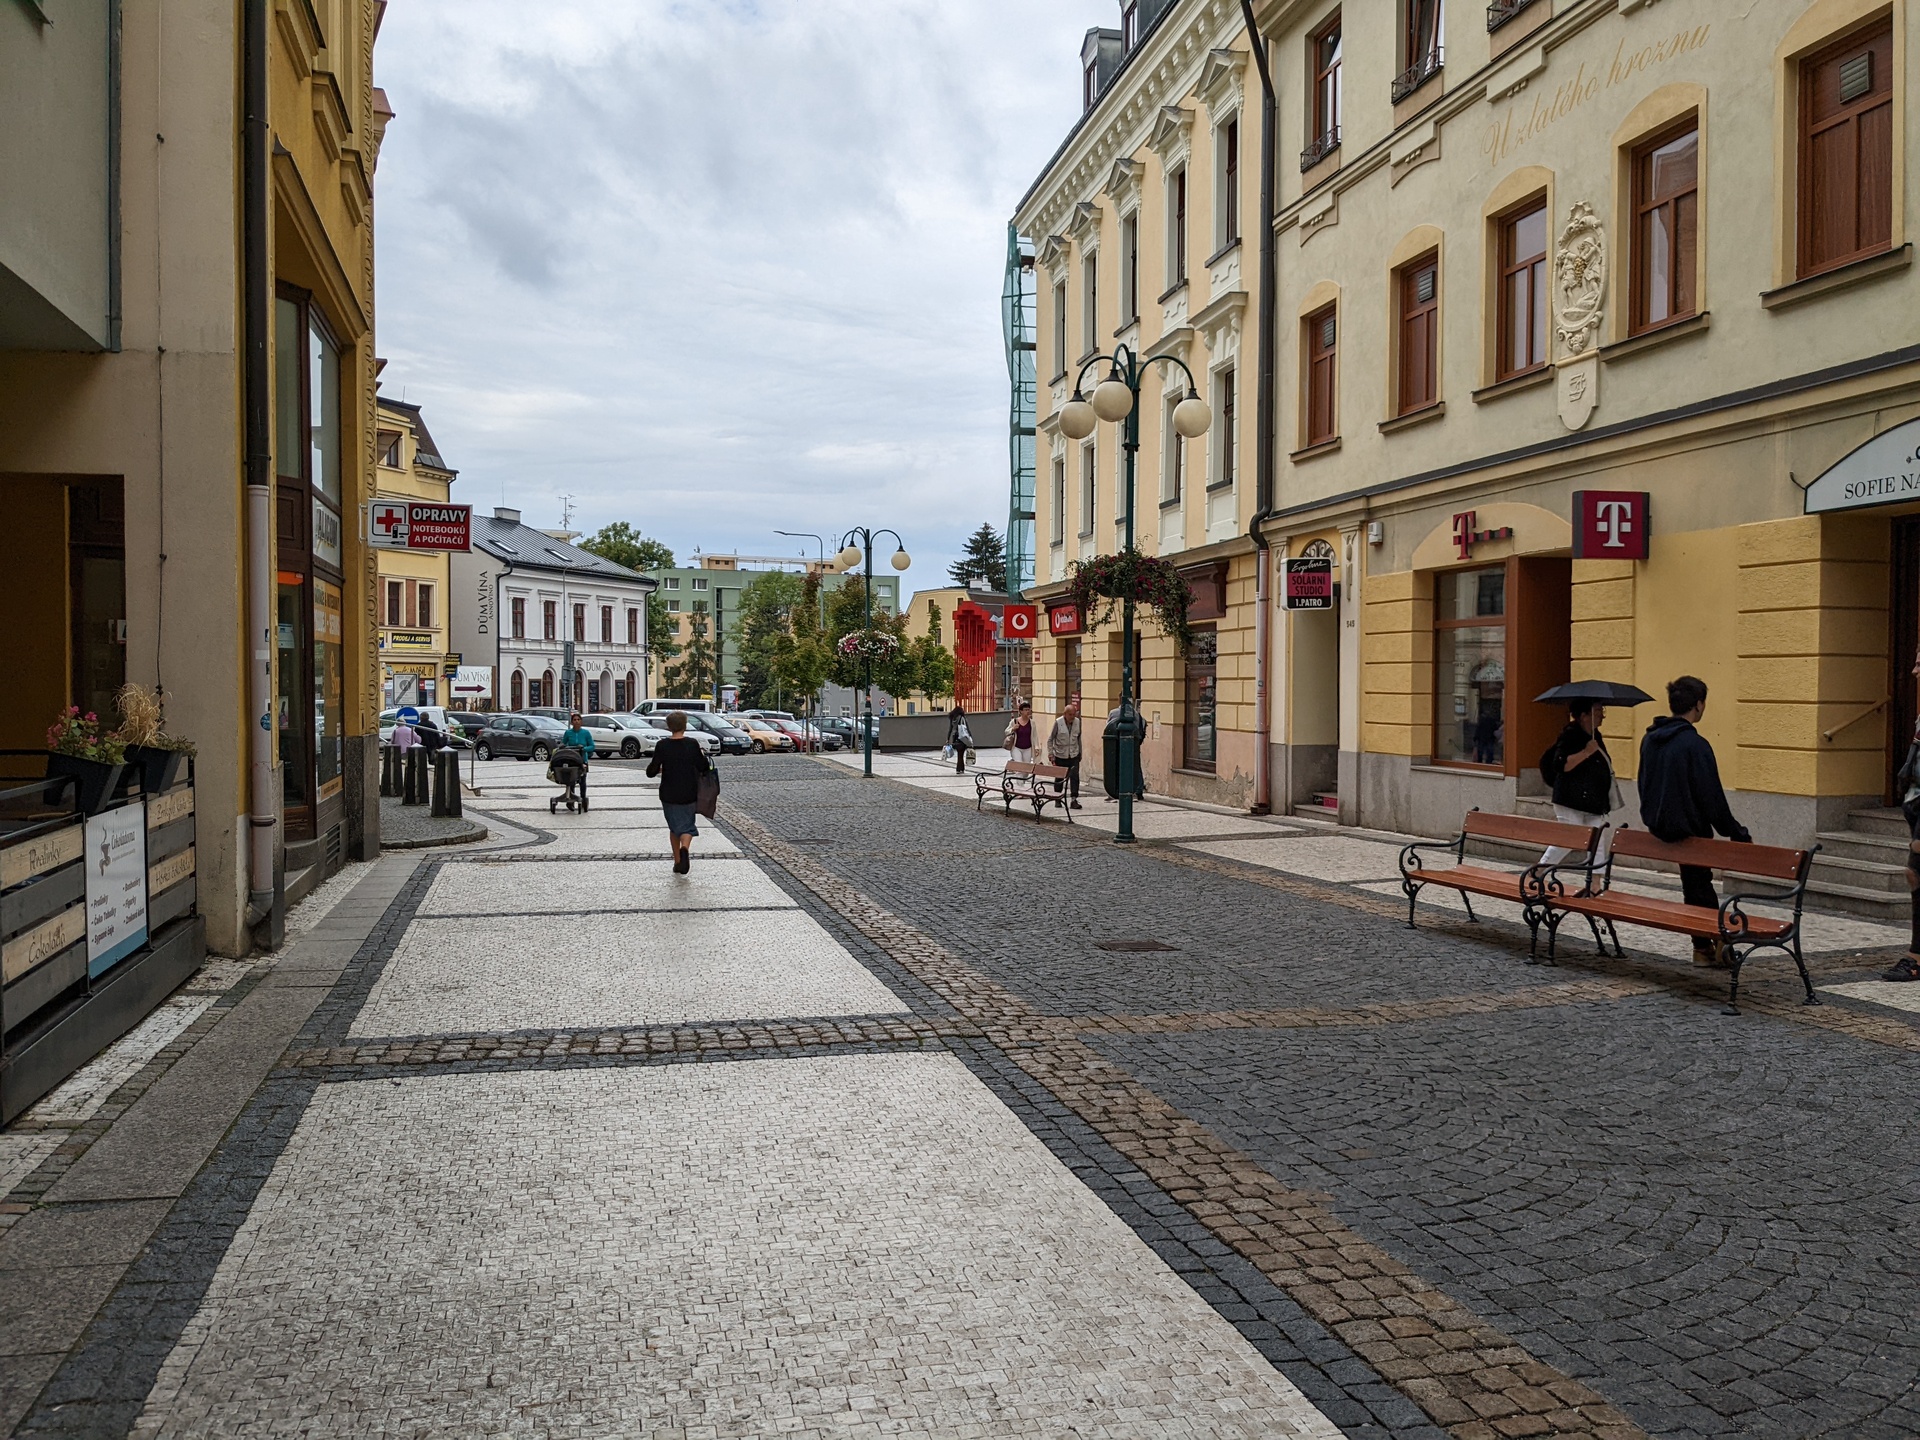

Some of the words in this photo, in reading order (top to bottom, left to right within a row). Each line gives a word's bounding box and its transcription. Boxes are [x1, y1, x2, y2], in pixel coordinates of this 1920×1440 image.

[1480, 106, 1513, 167] U
[1844, 476, 1896, 500] SOFIE
[411, 507, 467, 523] OPRAVY
[412, 524, 466, 535] NOTEBOOKŮ
[414, 535, 421, 543] A
[422, 534, 464, 545] POČÍTAČŮ
[1291, 573, 1326, 585] SOLÁRNÍ
[477, 570, 488, 602] VÍNA
[1295, 585, 1324, 595] STUDIO
[1294, 598, 1323, 607] 1.PATRO
[477, 604, 489, 634] DŮM
[586, 661, 602, 672] DŮM
[611, 661, 627, 672] VÍNA
[471, 671, 490, 682] VÍNA
[28, 841, 62, 871] Pralinky
